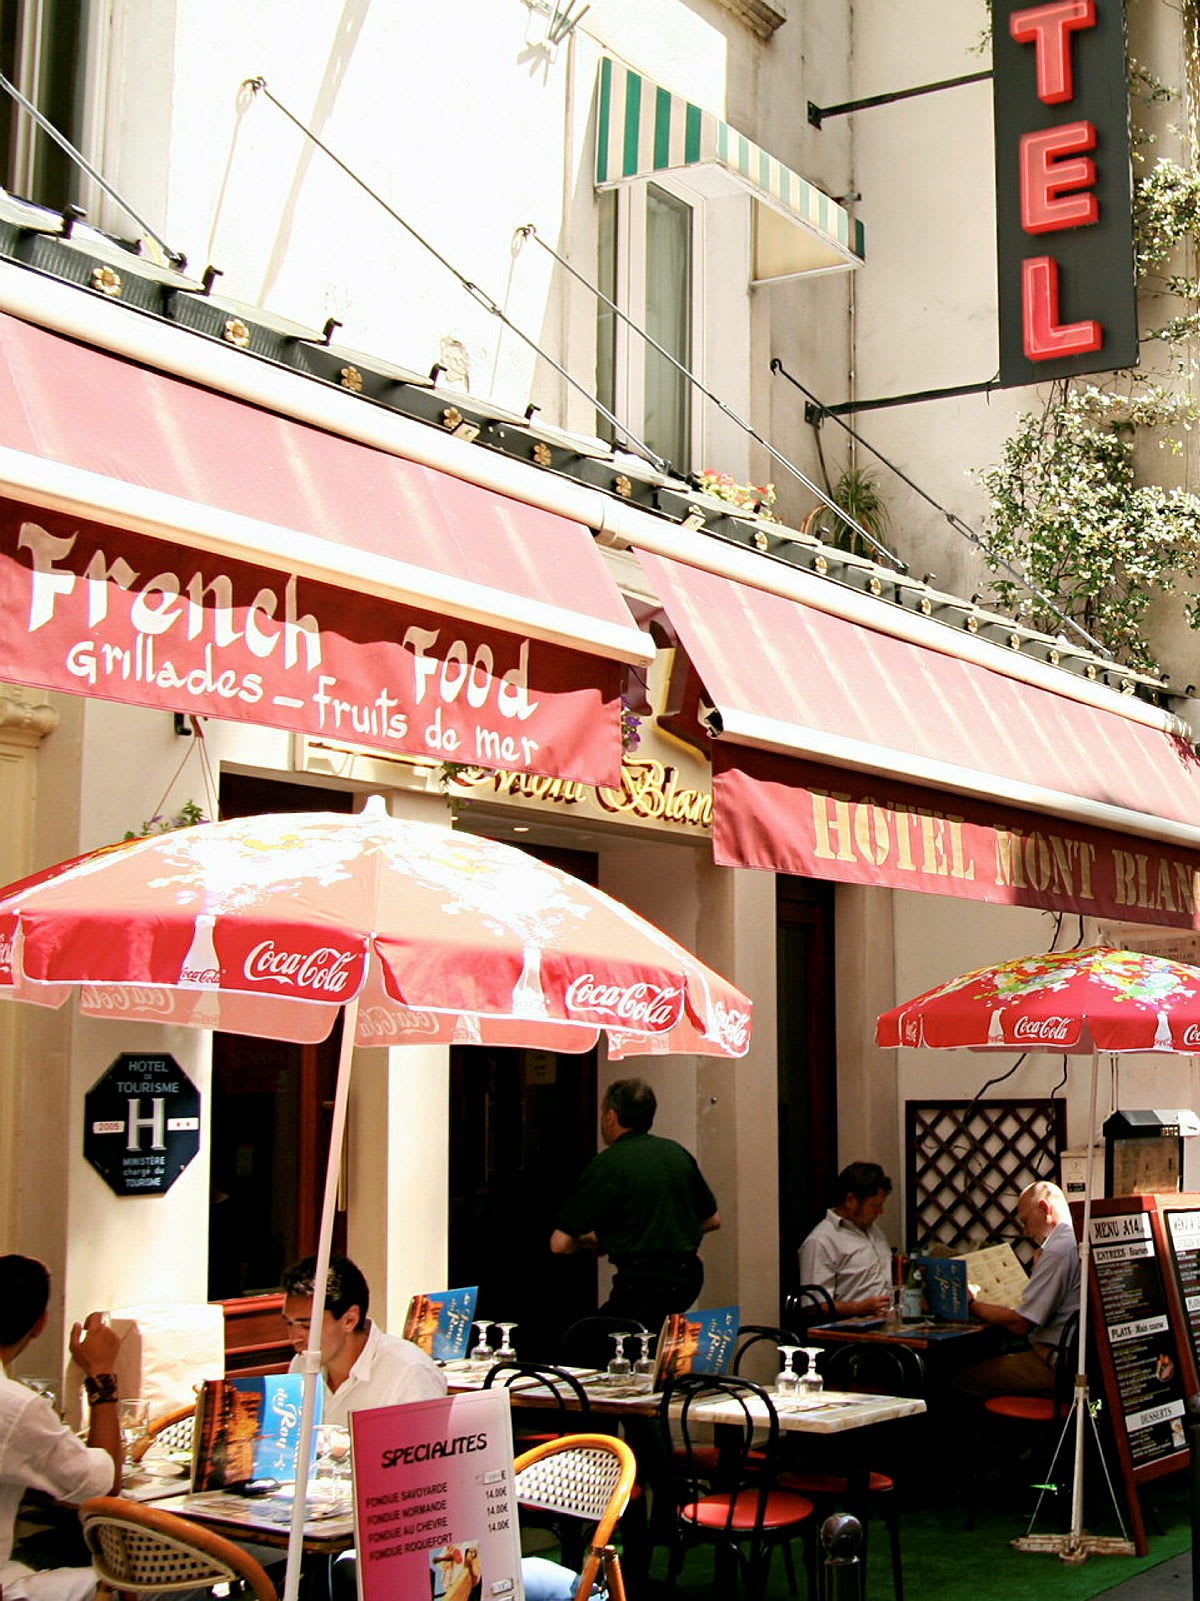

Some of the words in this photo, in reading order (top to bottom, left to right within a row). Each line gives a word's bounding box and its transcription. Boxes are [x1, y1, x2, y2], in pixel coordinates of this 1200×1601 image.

[1009, 0, 1102, 362] TEL
[16, 520, 323, 672] French
[402, 625, 542, 722] Food
[65, 632, 265, 704] Grillades
[313, 674, 410, 741] fruits
[424, 706, 462, 755] de
[473, 723, 542, 769] mer
[807, 786, 976, 881] HOTEL
[993, 822, 1097, 900] MONT
[244, 940, 358, 993] Coca-Cola
[565, 973, 684, 1026] Coca-Cola
[1014, 1016, 1073, 1040] Coca-Cola
[116, 1081, 180, 1094] TOURISME
[126, 1097, 167, 1151] H
[381, 1431, 489, 1470] SPECIALITES
[400, 1481, 449, 1502] SAVOYARDE
[402, 1499, 448, 1517] NORMANDE
[403, 1523, 416, 1536] AU
[417, 1516, 449, 1533] CHEVRE
[404, 1532, 454, 1555] ROQUEFORT
